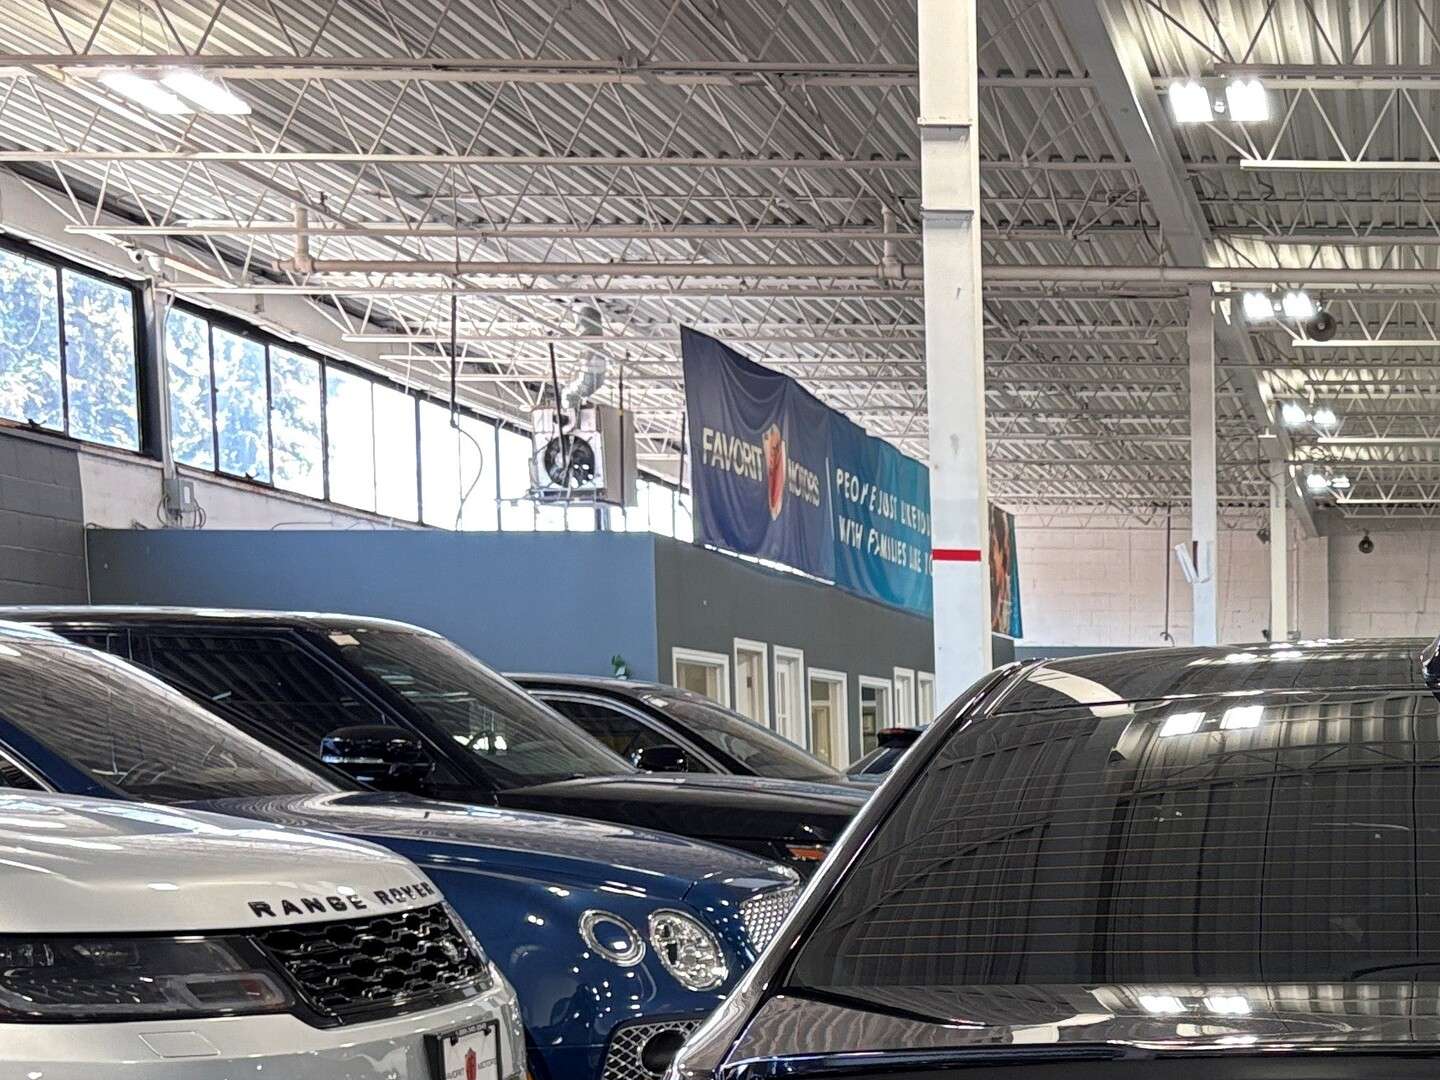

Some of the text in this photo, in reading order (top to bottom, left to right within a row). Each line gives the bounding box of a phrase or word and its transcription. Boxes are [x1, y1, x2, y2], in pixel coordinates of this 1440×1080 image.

[702, 427, 820, 507] FAVORIT MOTORS
[248, 882, 436, 919] RANGE ROVER
